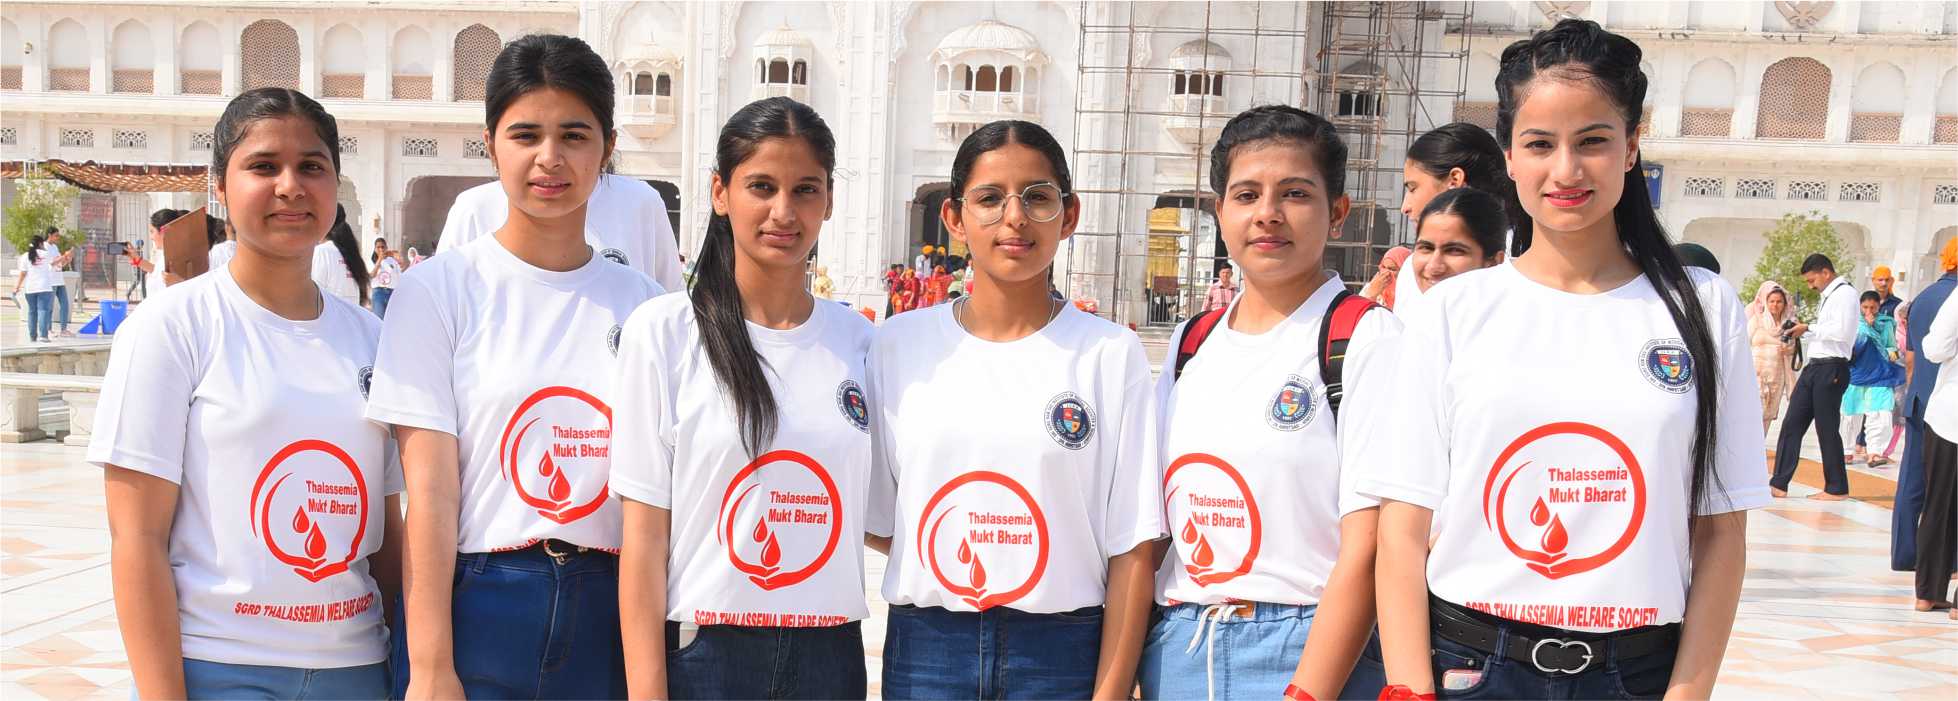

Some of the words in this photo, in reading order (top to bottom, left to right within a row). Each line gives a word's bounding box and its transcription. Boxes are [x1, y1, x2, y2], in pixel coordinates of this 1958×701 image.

[553, 443, 577, 458] Mukt
[1548, 466, 1628, 482] Thalassemia
[305, 480, 358, 496] Thalassemia
[1549, 487, 1580, 503] Mukt
[1584, 486, 1627, 503] Bharat
[770, 491, 829, 505] Thalassemia
[1188, 493, 1245, 509] Thalassemia
[308, 498, 327, 513] Mukt
[330, 499, 357, 515] Bharat
[768, 508, 792, 523] Mukt
[794, 508, 827, 524] Bharat
[968, 511, 1033, 526] Thalassemia
[1212, 512, 1246, 529] Bharat
[969, 529, 994, 544] Mukt
[997, 529, 1033, 545] Bharat
[234, 602, 262, 616] SGRD
[263, 604, 325, 622] THALASSEMIA
[1493, 603, 1564, 626] THALASSEMIA
[1568, 605, 1616, 628] WELFARE
[1617, 607, 1659, 628] SOCIETY
